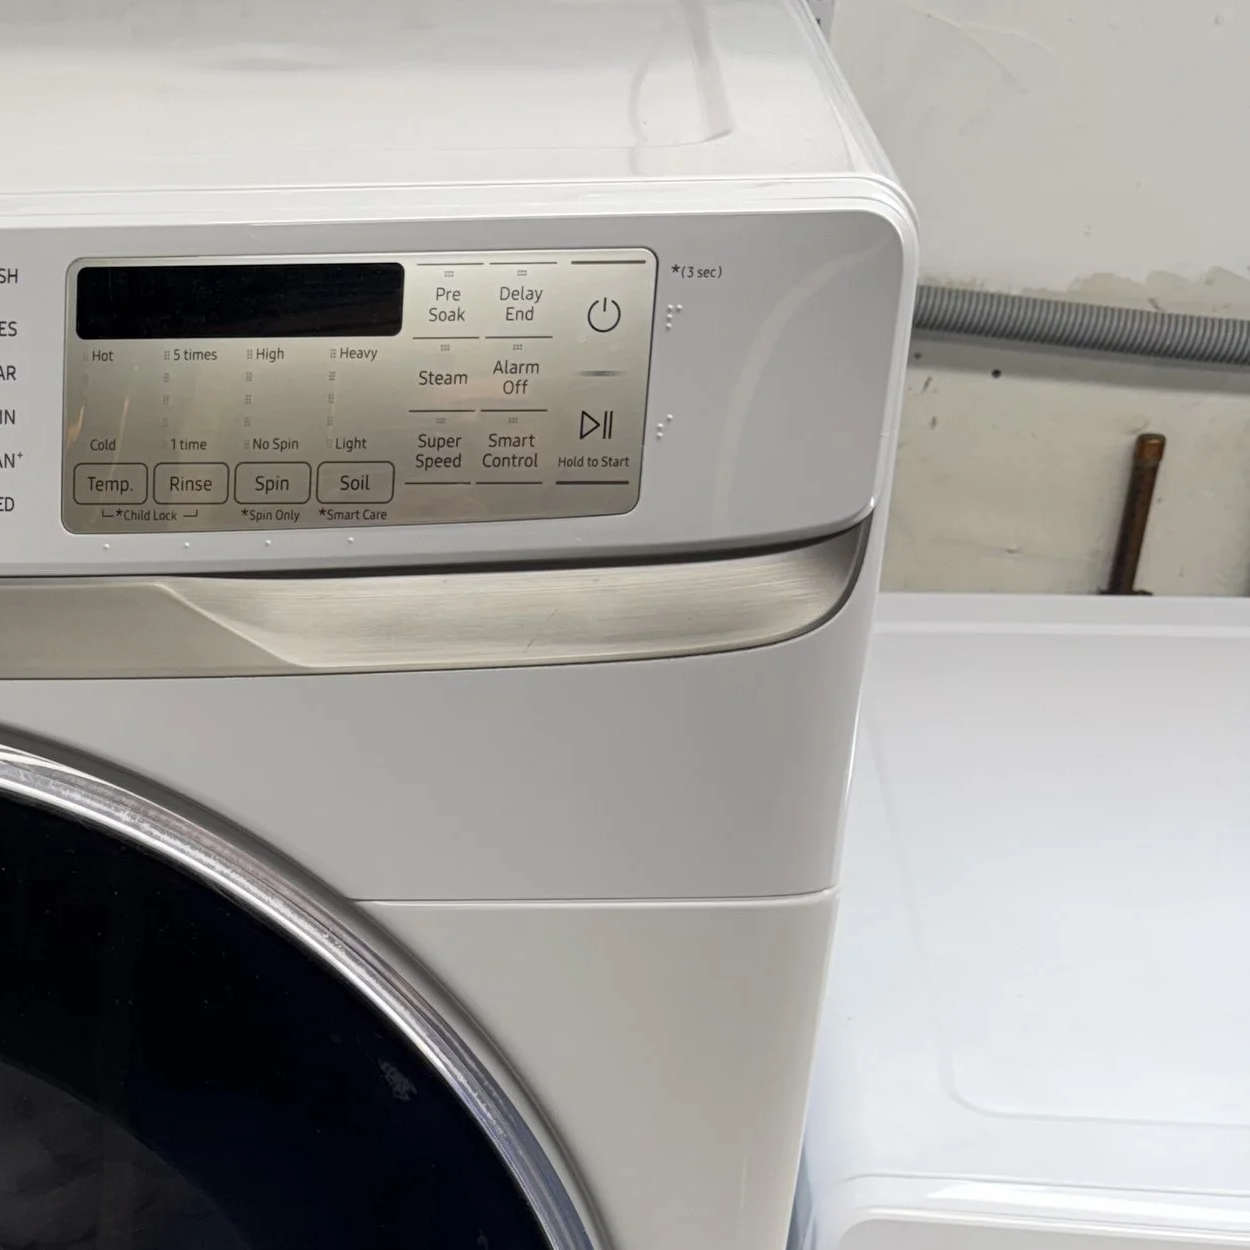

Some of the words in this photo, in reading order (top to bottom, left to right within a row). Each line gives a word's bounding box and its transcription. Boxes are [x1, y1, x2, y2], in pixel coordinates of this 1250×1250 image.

[697, 265, 723, 279] sec)
[436, 287, 461, 302] Pre
[499, 285, 543, 304] Delay
[428, 307, 465, 322] Soak
[505, 306, 535, 321] End
[92, 350, 114, 362] Hot
[173, 349, 181, 361] 5
[183, 349, 218, 361] times
[256, 348, 284, 362] High
[339, 348, 378, 361] Heavy
[493, 360, 540, 375] Alarm
[418, 370, 468, 386] Steam
[502, 379, 528, 395] Off
[90, 439, 116, 451] Cold
[170, 439, 177, 450] 1
[179, 439, 207, 450] time
[252, 438, 270, 450] No
[272, 438, 299, 452] Spin
[335, 437, 367, 452] Light
[417, 433, 462, 451] Super
[488, 433, 535, 448] Smart
[415, 453, 462, 471] Speed
[482, 453, 538, 468] Control
[558, 456, 584, 467] Hold
[587, 457, 598, 467] to
[601, 456, 630, 467] Start
[87, 477, 133, 495] Temp.
[169, 476, 213, 491] Rinse
[255, 476, 290, 494] Spin
[339, 475, 370, 491] Soil
[153, 510, 177, 521] Lock
[275, 510, 300, 523] Only
[362, 509, 388, 521] Care
